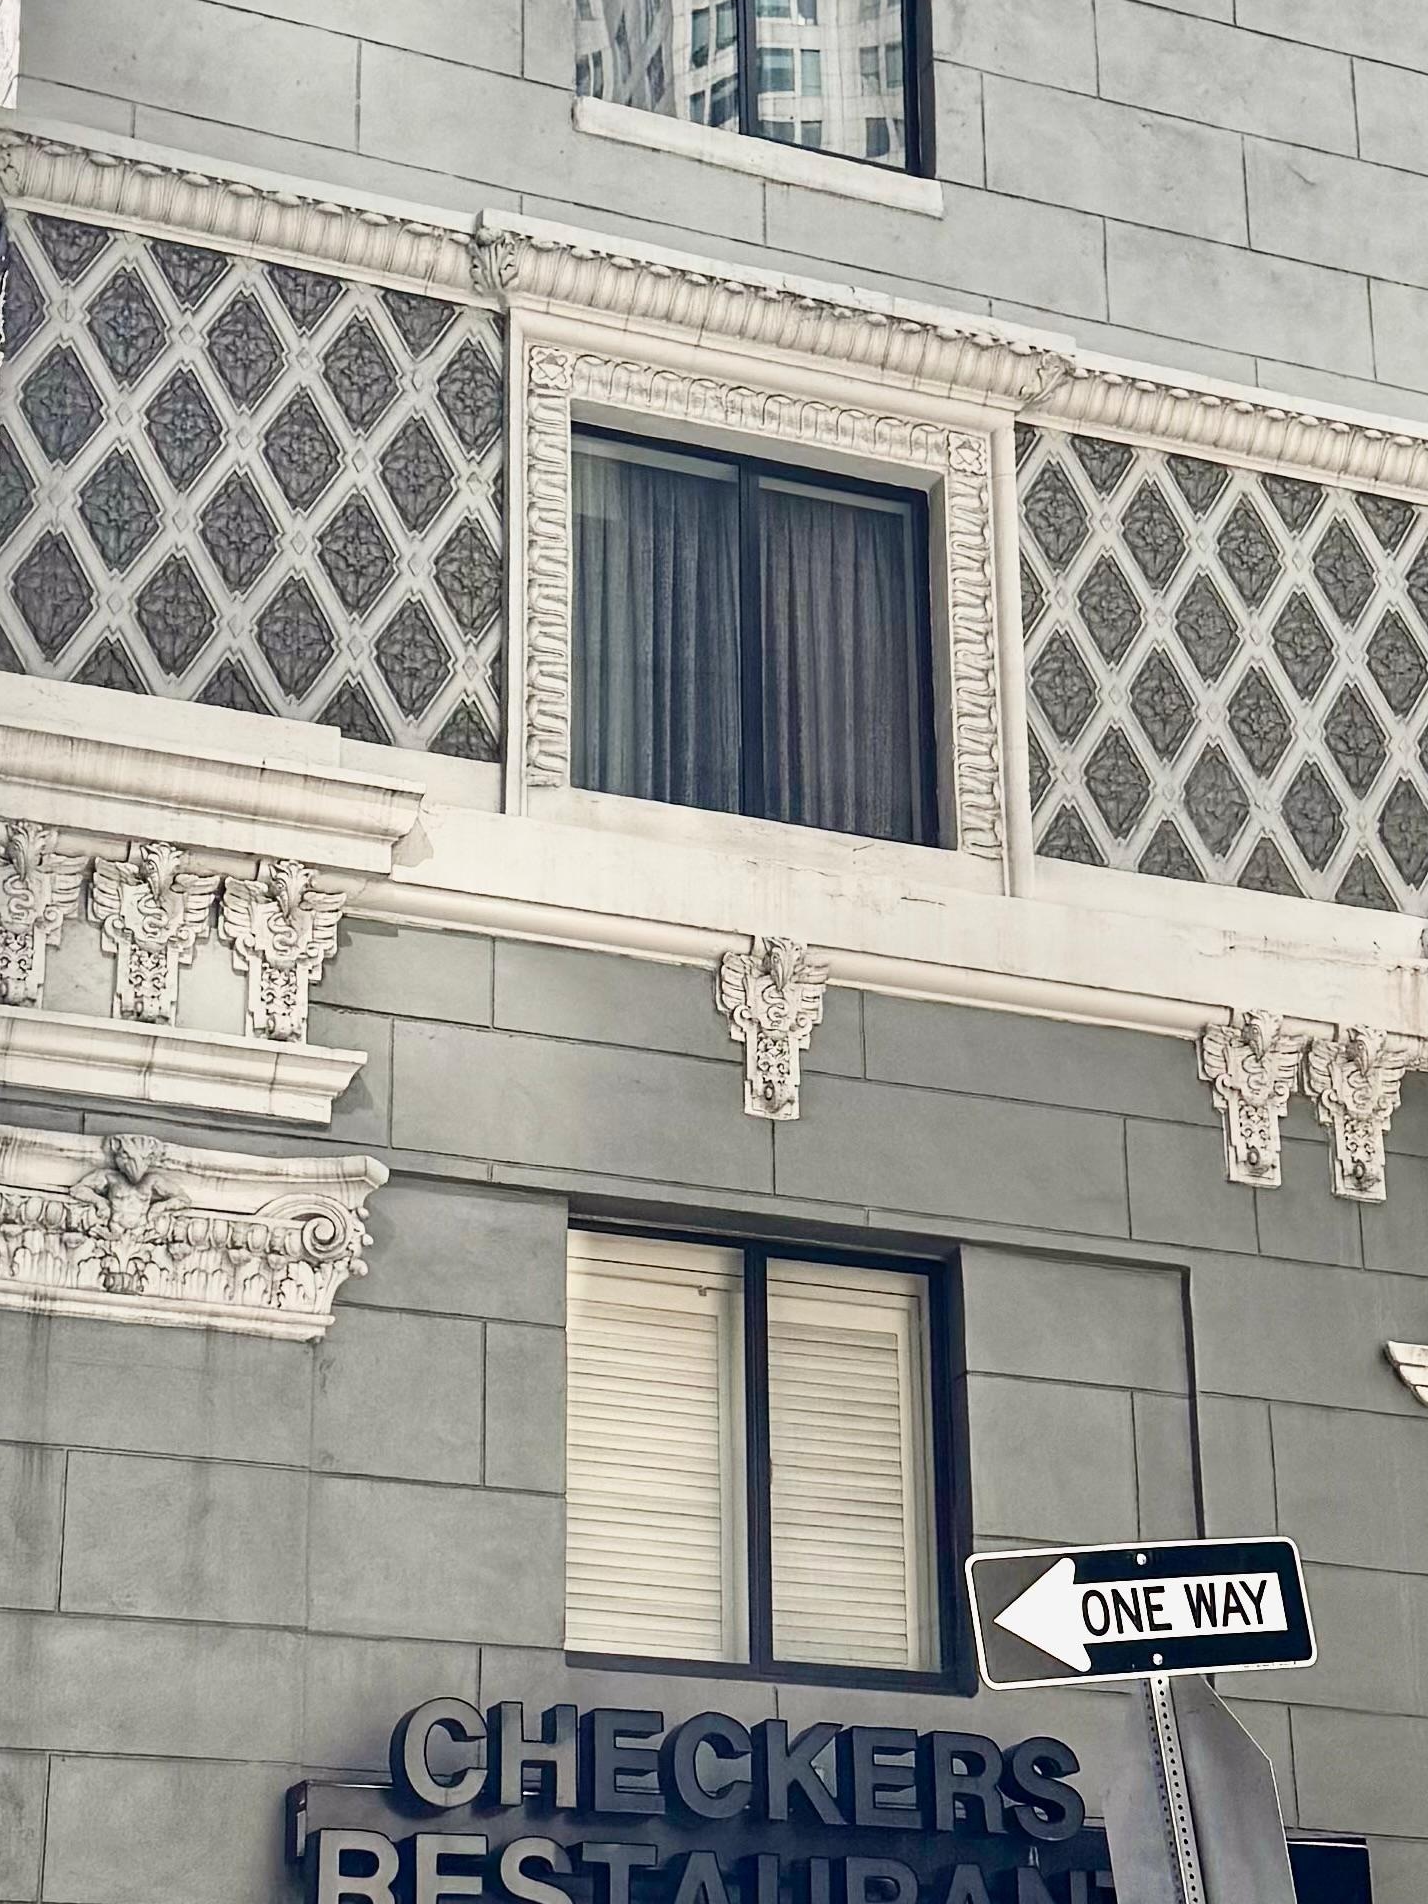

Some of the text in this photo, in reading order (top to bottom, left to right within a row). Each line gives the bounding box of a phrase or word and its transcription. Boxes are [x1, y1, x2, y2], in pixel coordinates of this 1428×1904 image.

[1082, 1580, 1267, 1637] ONE WAY
[389, 1696, 1086, 1842] CHECKERS
